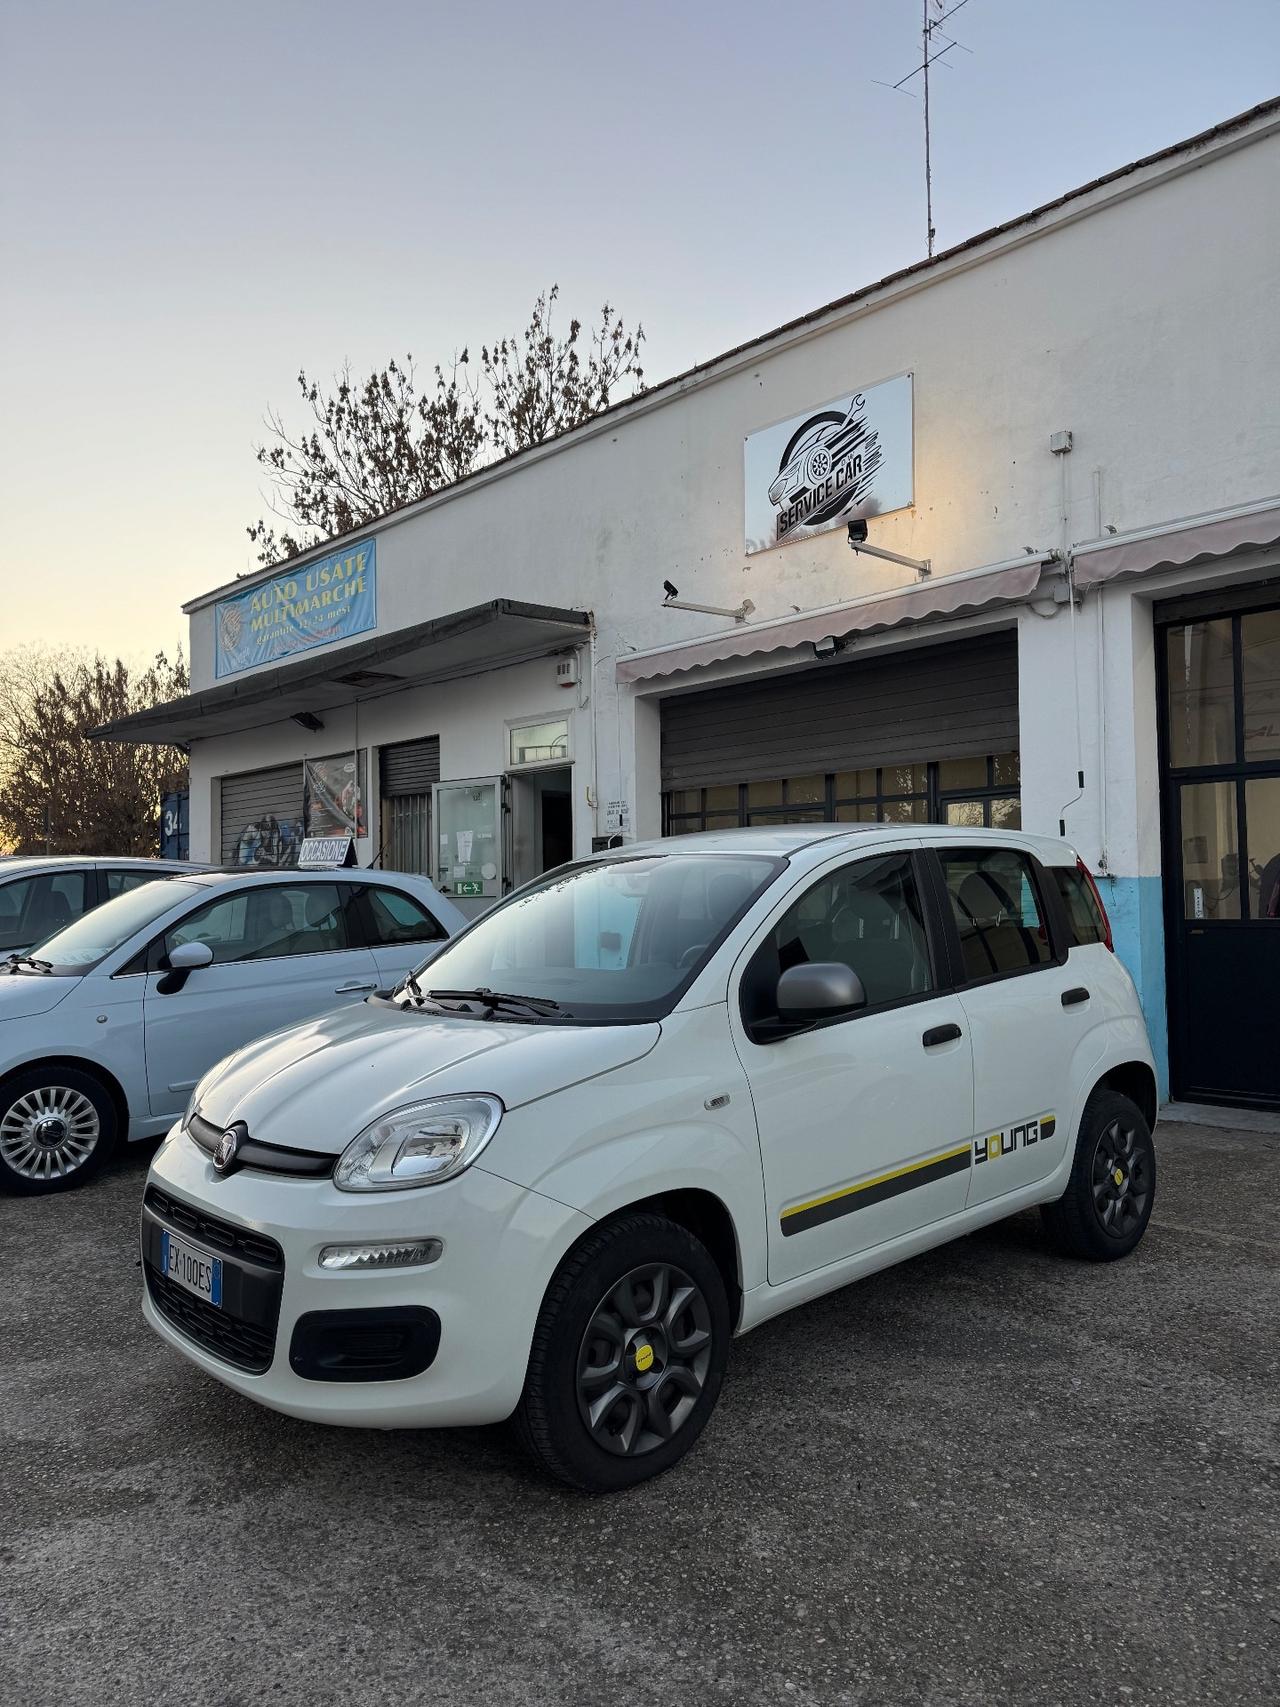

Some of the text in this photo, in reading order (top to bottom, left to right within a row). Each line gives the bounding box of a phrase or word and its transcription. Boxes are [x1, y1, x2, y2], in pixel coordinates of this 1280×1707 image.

[779, 454, 863, 533] SERVICE CAR
[251, 552, 366, 613] AUTO USATE
[251, 576, 366, 632] MULTIMARCHE
[300, 840, 348, 861] OCCASIONE
[974, 1120, 1038, 1165] YOUNG
